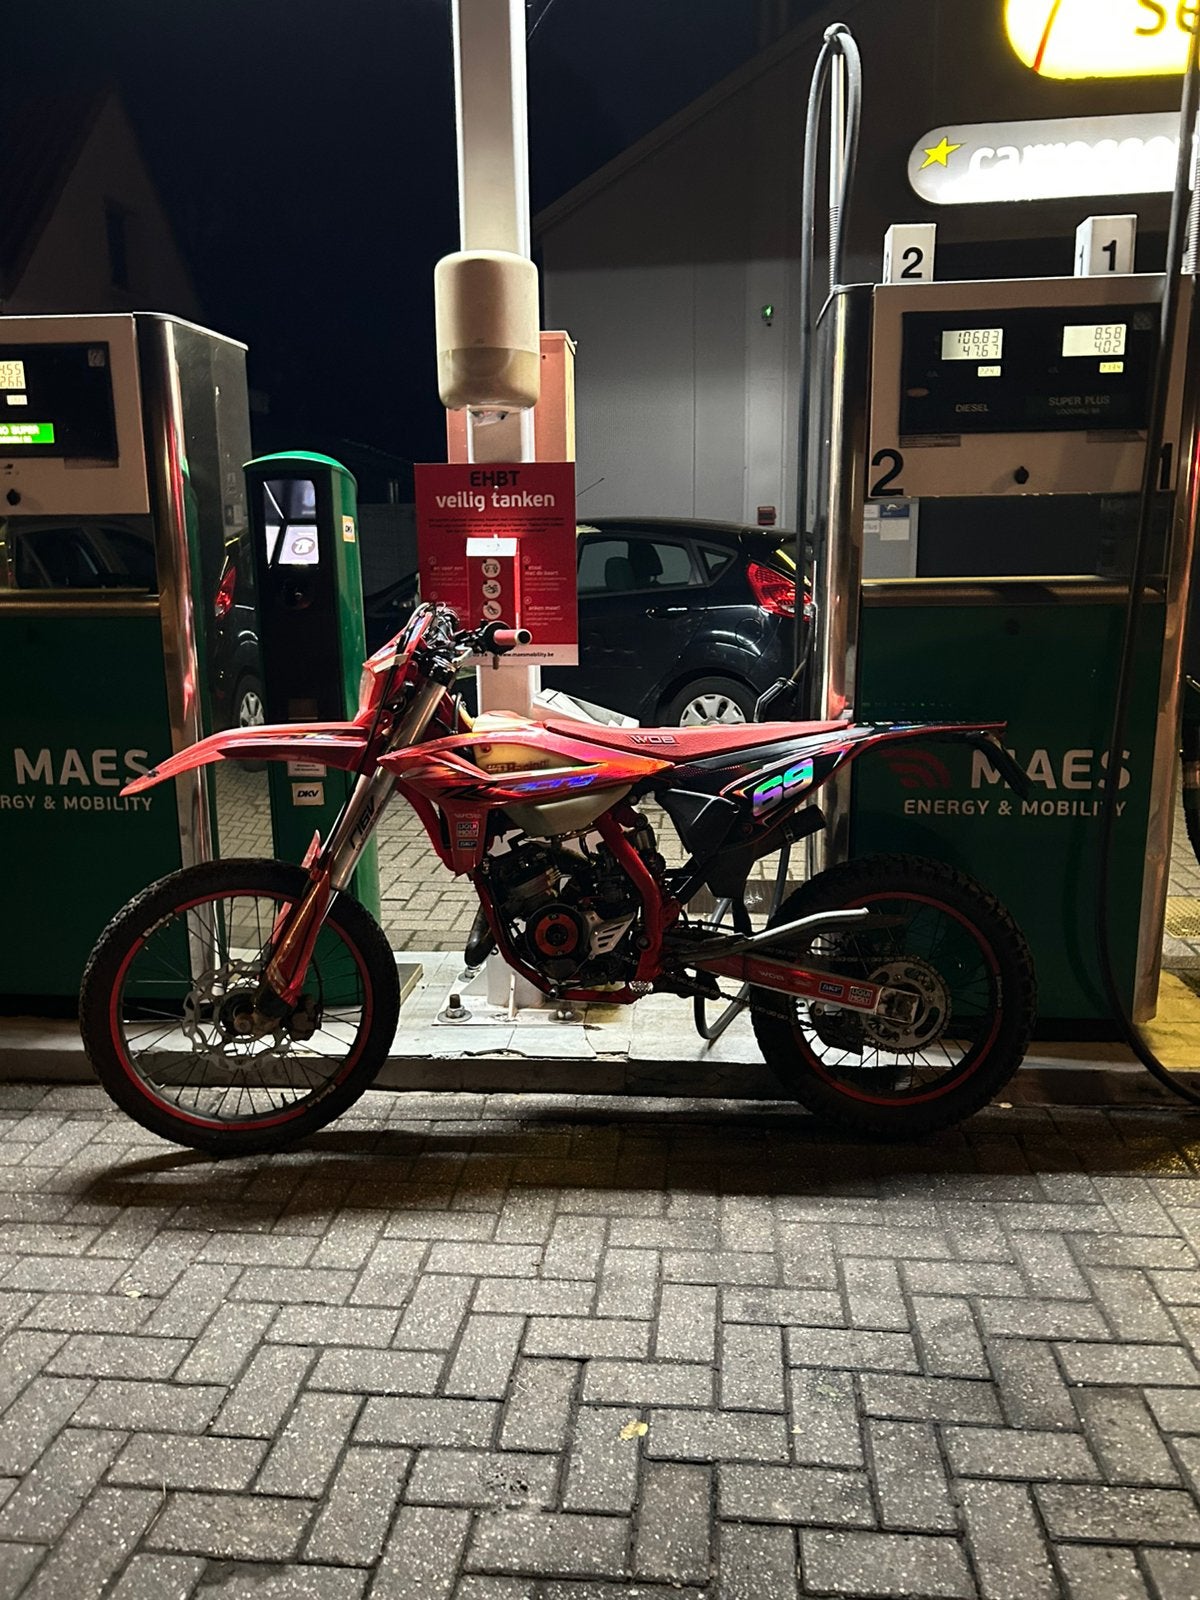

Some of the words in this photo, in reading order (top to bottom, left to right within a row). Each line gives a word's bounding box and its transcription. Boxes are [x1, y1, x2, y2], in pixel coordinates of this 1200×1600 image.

[901, 246, 923, 278] 2
[1102, 239, 1117, 271] 1
[958, 330, 999, 344] 106.83
[1094, 326, 1122, 340] 8.58
[963, 344, 999, 357] 47.67
[955, 403, 989, 413] DIESEL
[1048, 396, 1081, 407] SUPER
[1084, 395, 1111, 405] PLUS
[870, 449, 904, 497] 2
[1160, 442, 1173, 490] 1
[469, 470, 520, 487] EHBT
[436, 491, 485, 512] veilig
[491, 490, 555, 508] tanken
[14, 748, 149, 785] MAES
[297, 790, 319, 798] DKV
[753, 757, 814, 817] 69
[44, 796, 56, 810] &
[64, 796, 152, 811] MOBILITY
[904, 799, 988, 815] ENERGY
[998, 801, 1012, 816] &
[1021, 800, 1127, 817] MOBILIY
